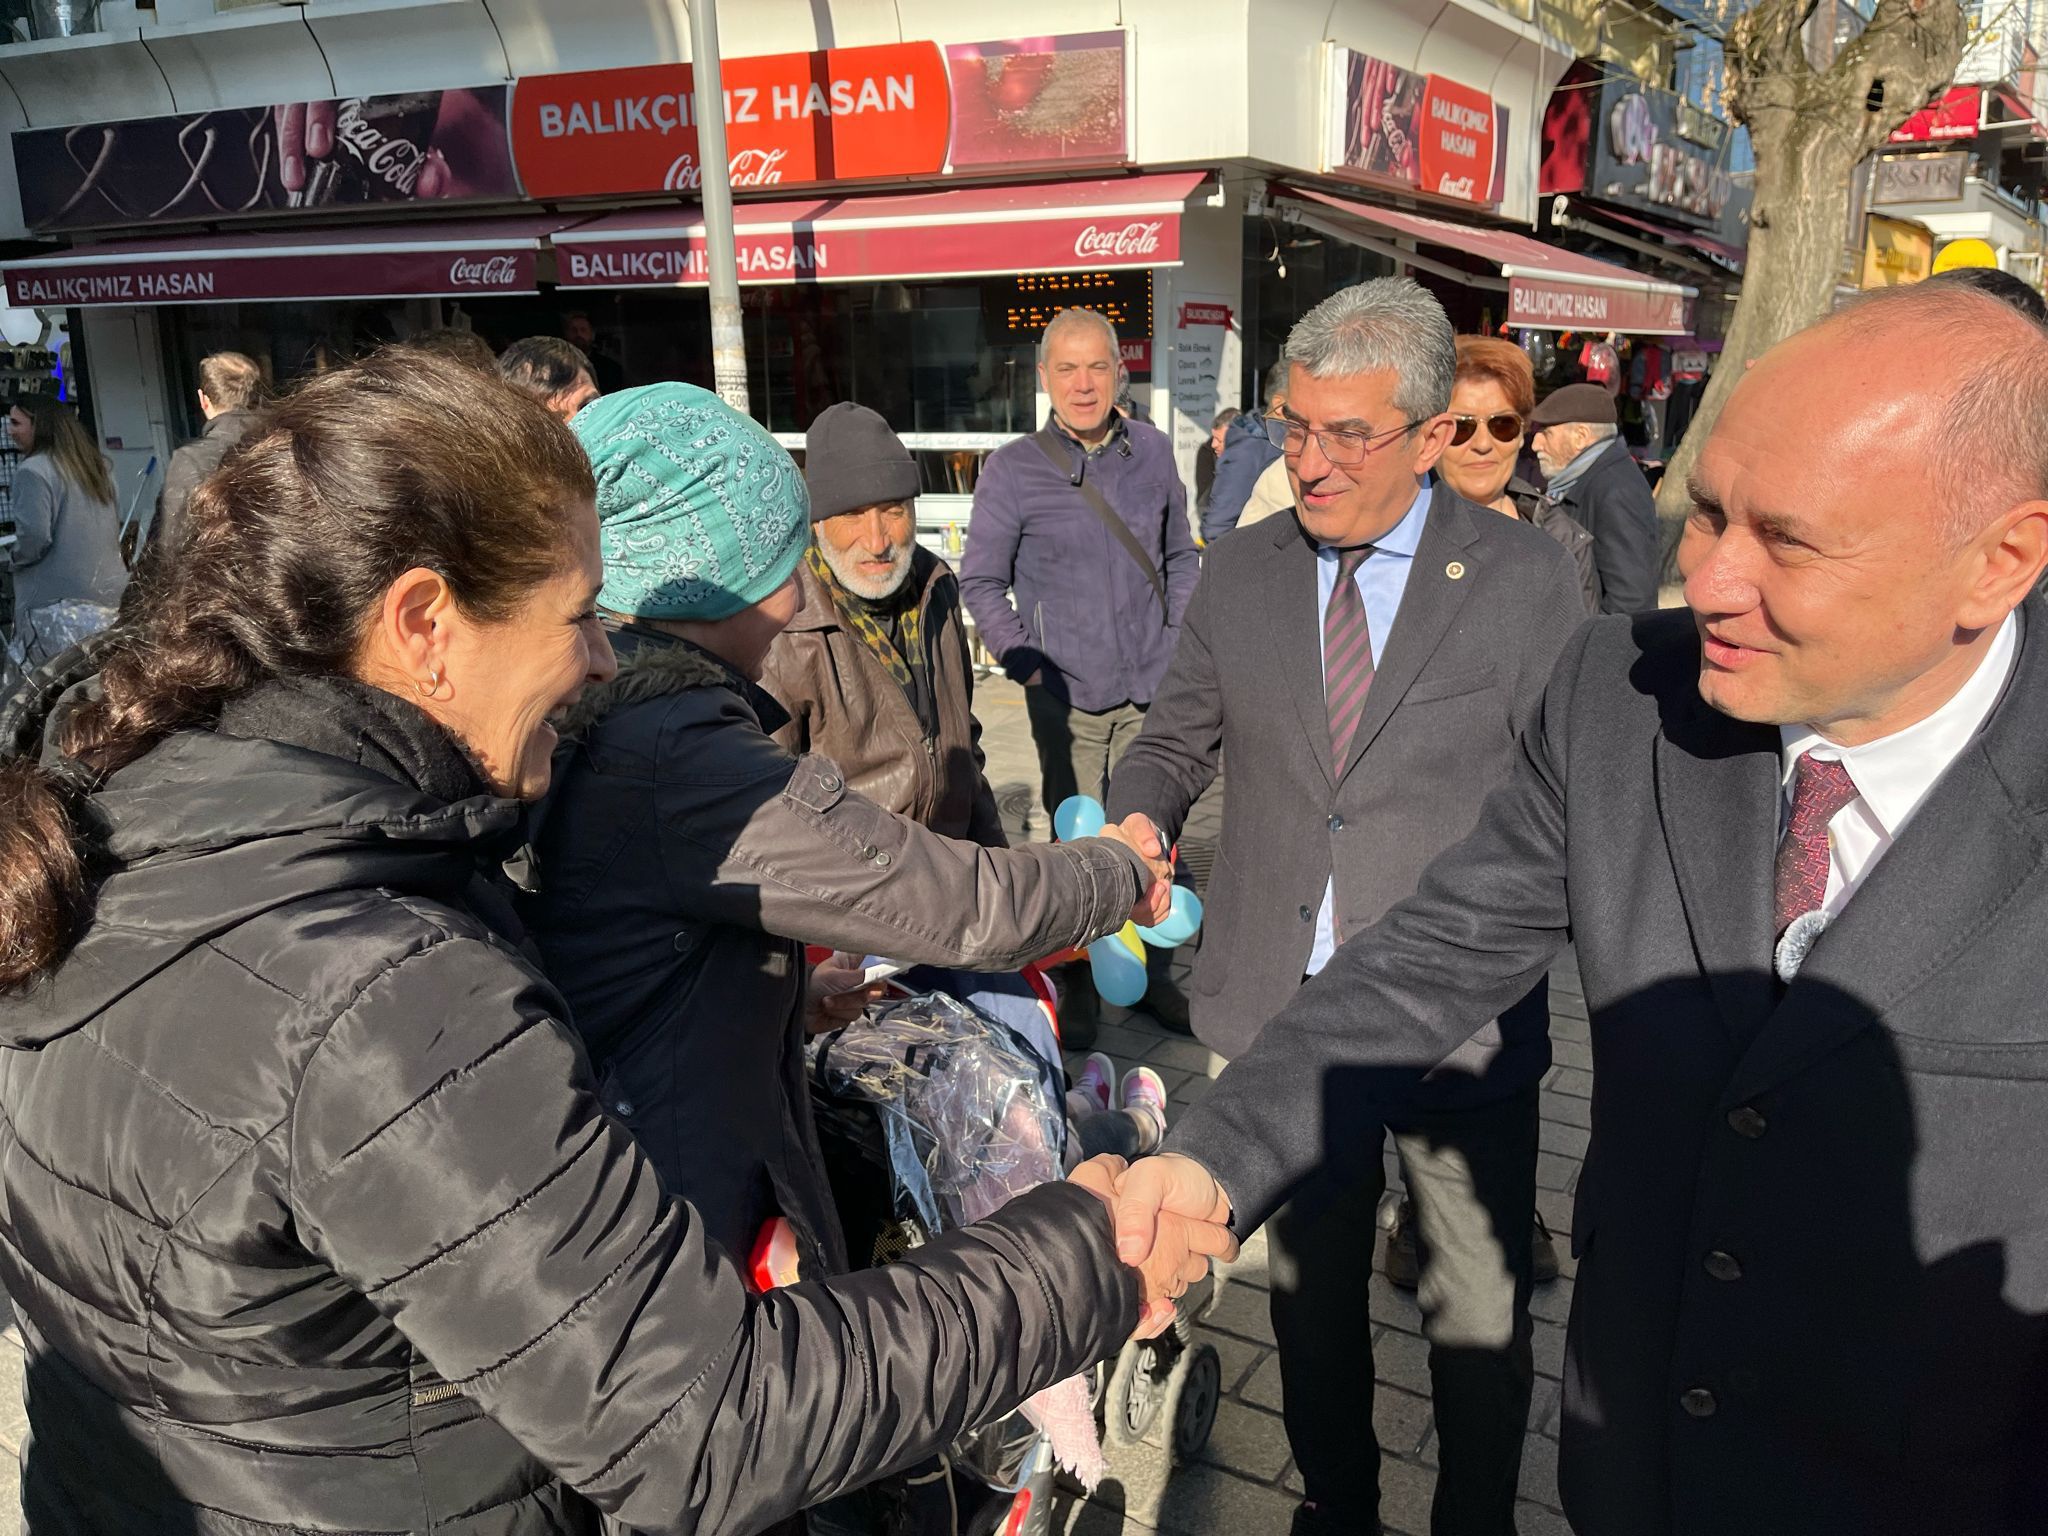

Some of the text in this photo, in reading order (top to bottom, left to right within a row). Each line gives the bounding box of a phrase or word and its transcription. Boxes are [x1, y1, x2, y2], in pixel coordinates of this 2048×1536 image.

[540, 75, 914, 138] BALIKÇIIZ HASAN
[1431, 97, 1489, 134] BALIKÇIMIZ
[1441, 130, 1477, 159] HASAN
[571, 244, 828, 279] BALIKÇIMI HASAN
[17, 272, 215, 302] BALIKÇIMIZ HASAN
[1513, 287, 1607, 320] BALIKÇIMIZ HASAN
[1119, 344, 1144, 361] SAN
